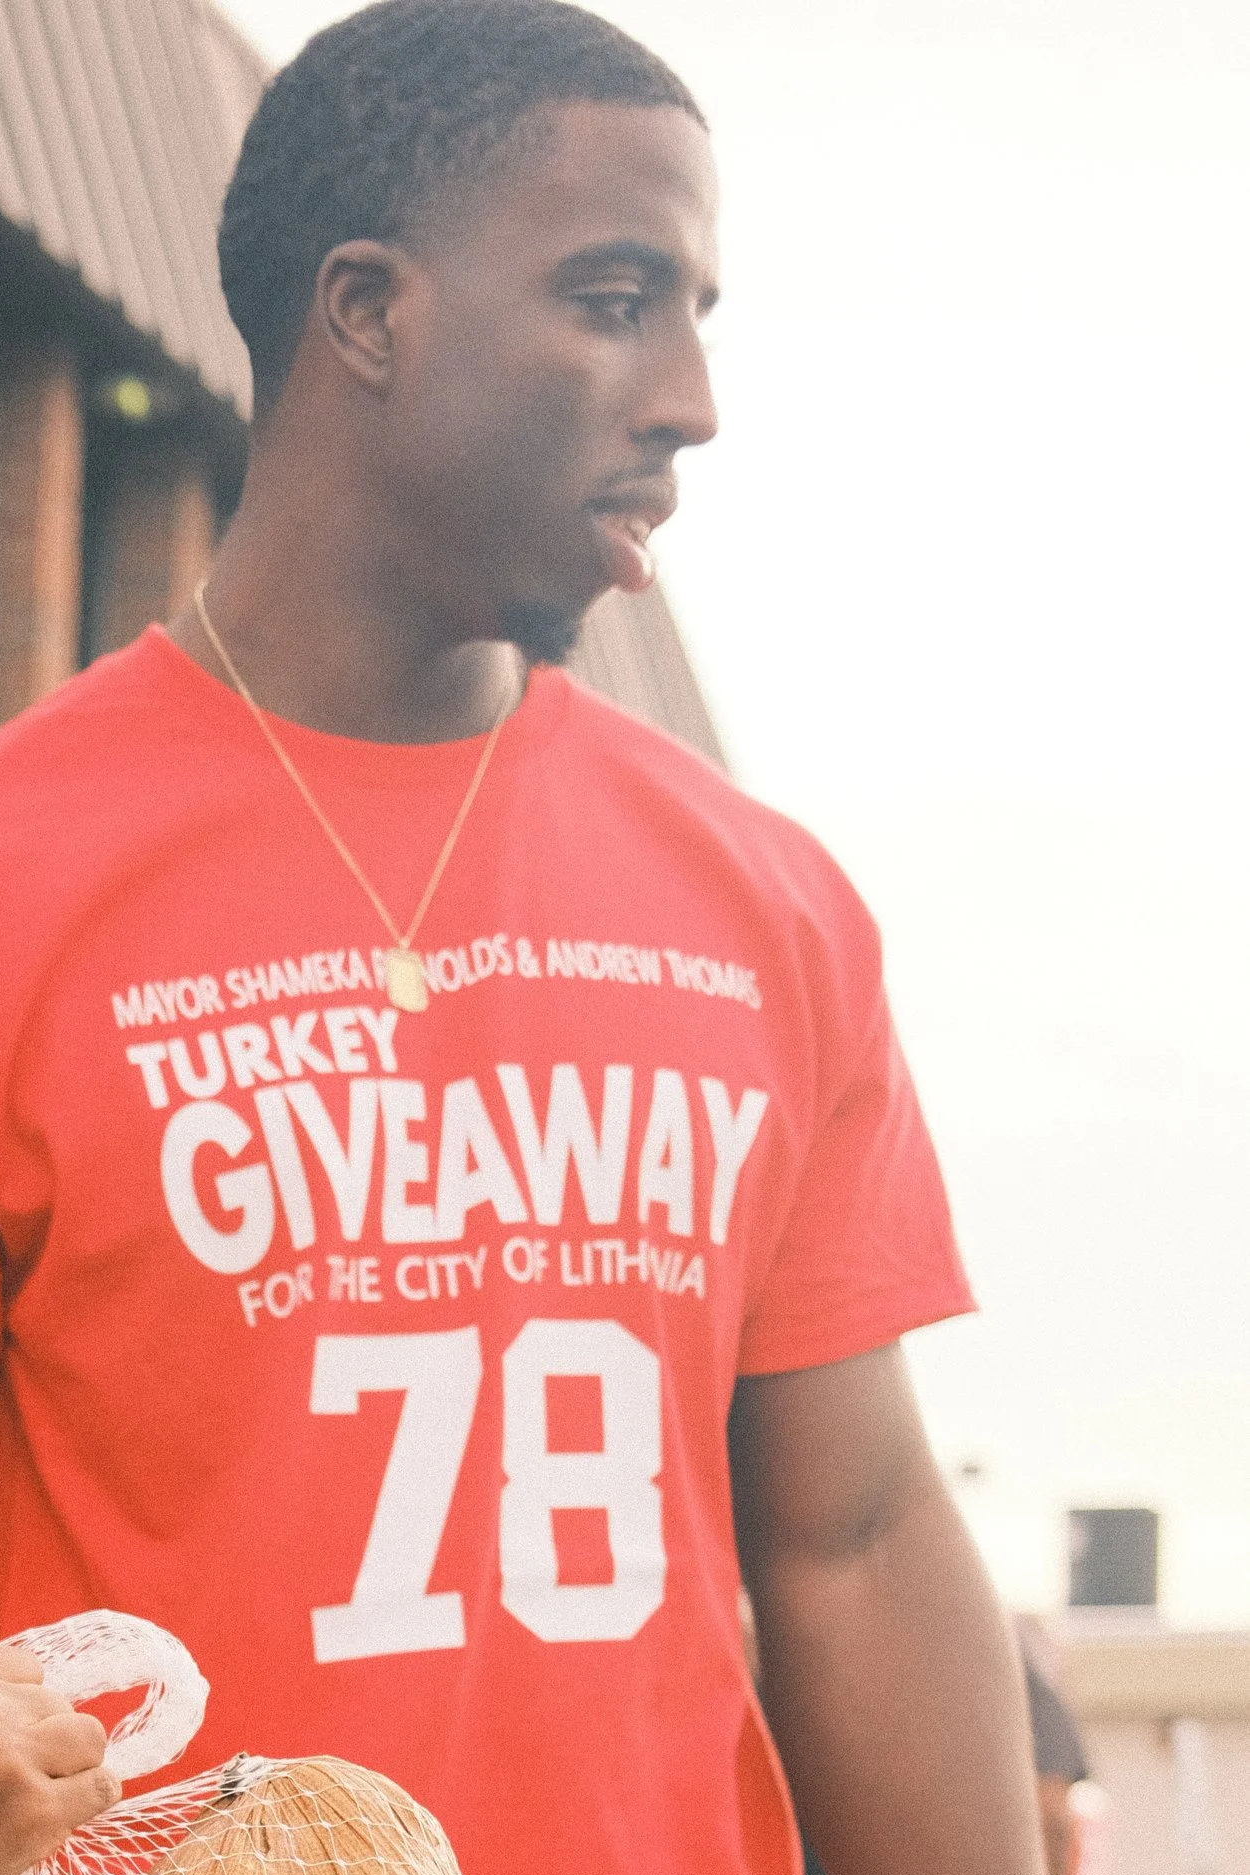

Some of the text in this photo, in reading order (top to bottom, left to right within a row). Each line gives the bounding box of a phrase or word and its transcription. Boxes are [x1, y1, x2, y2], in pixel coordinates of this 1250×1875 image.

[111, 973, 225, 1029] MAYOR
[225, 947, 373, 1009] SHAMEKA
[371, 932, 514, 993] RNOLDS
[516, 936, 542, 978] &
[546, 938, 662, 986] ANDREW
[126, 1005, 400, 1109] TURKEY
[160, 1062, 770, 1275] GIVEAWAY
[238, 1262, 314, 1328] FOR
[395, 1245, 487, 1301] CITY
[502, 1236, 548, 1284] OF
[560, 1237, 705, 1300] LITHNIA
[308, 1318, 668, 1666] 78
